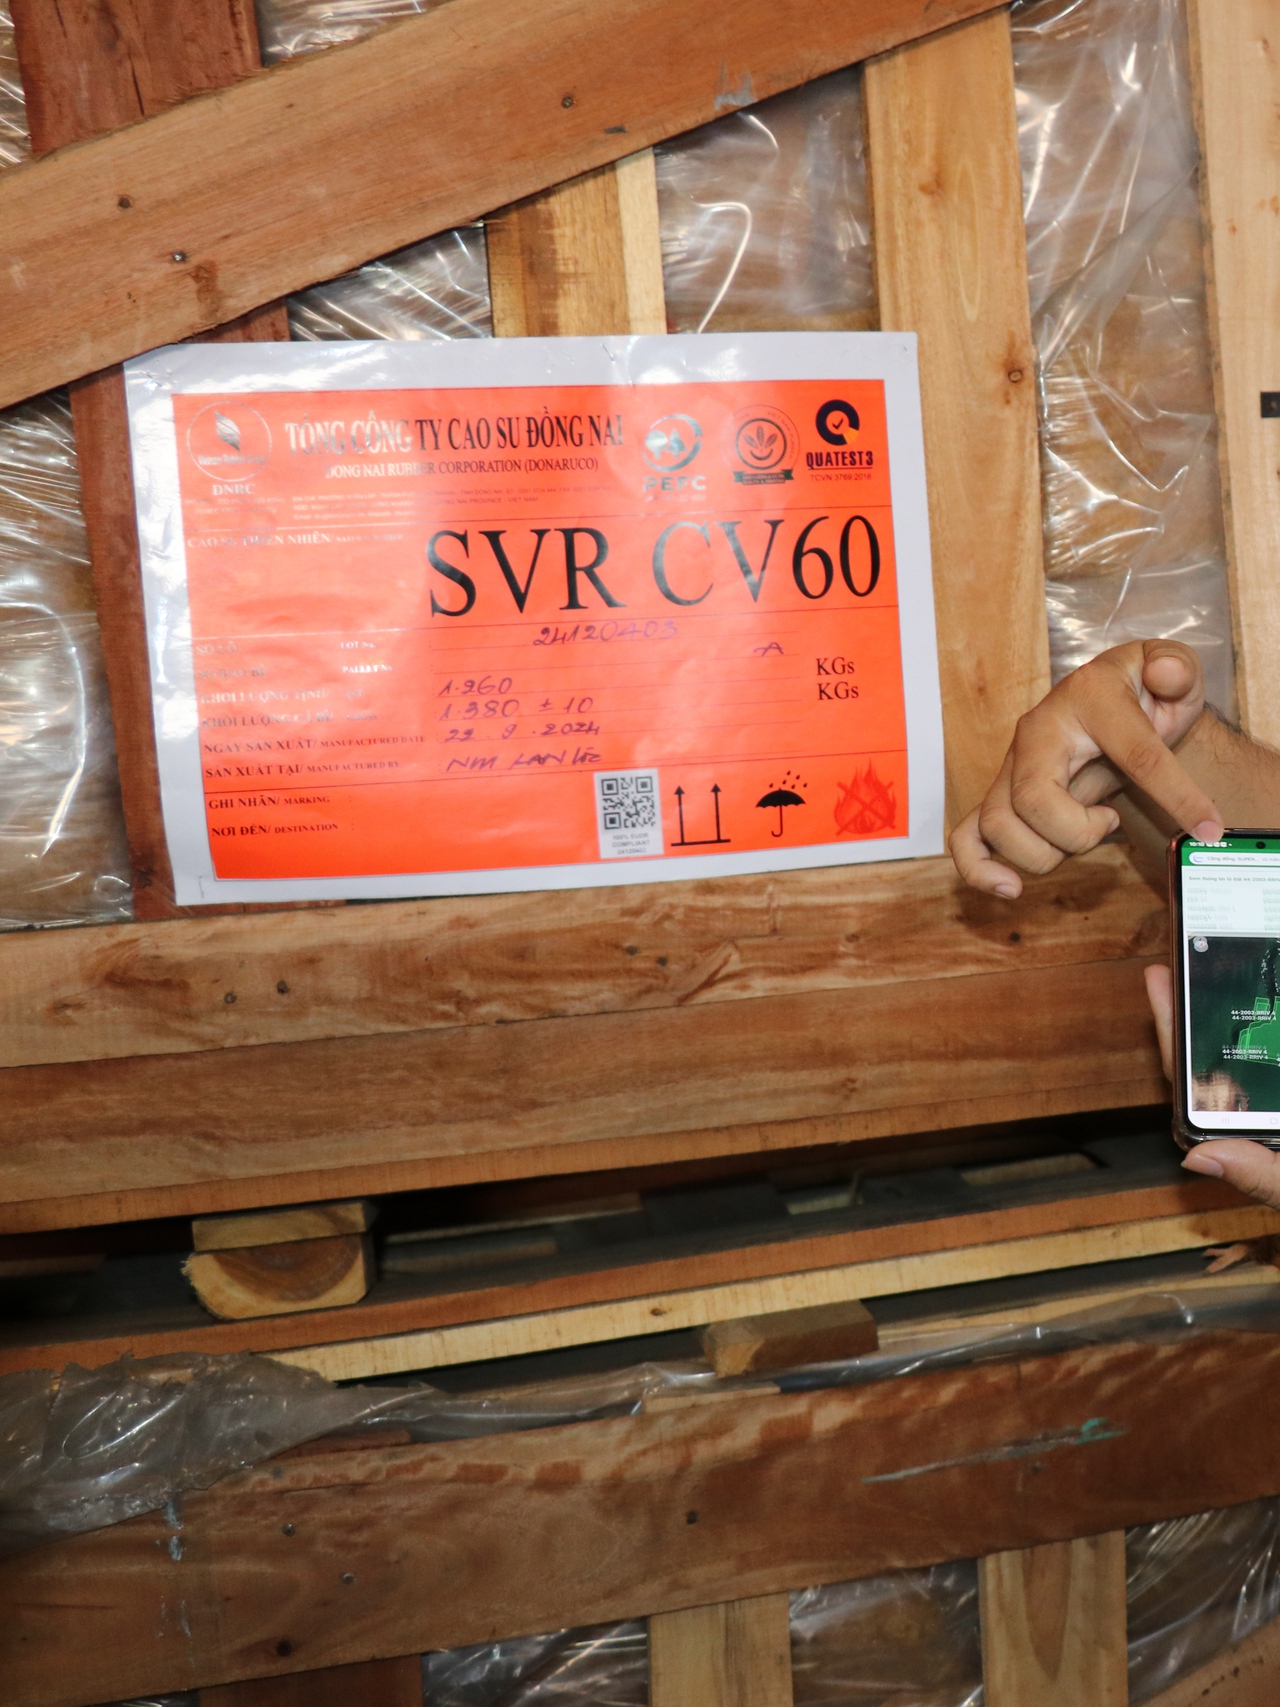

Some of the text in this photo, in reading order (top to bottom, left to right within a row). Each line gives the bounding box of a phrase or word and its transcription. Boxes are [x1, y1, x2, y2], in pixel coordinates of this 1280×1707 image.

[350, 409, 412, 454] CÔNG
[415, 418, 442, 450] TY
[447, 417, 491, 450] CAO
[496, 416, 520, 449] SU
[526, 406, 584, 448] ĐỒNG
[589, 414, 624, 446] NAI
[325, 457, 598, 478] DONG NAI RUBBER CORPORATION (DONARUCO)
[212, 483, 256, 496] DNRC
[643, 475, 707, 491] PEFC
[426, 525, 627, 618] SVR
[532, 619, 679, 646] 24120403
[816, 656, 855, 676] KGs
[817, 681, 859, 701] KGs
[564, 696, 593, 714] 10
[321, 736, 399, 748] MANUFACTURED
[400, 735, 425, 743] DATE
[306, 761, 386, 773] MANUFACTURED
[388, 760, 399, 768] BY
[208, 798, 234, 810] GHI
[283, 795, 330, 805] MARKING
[274, 823, 339, 834] DESTINATION
